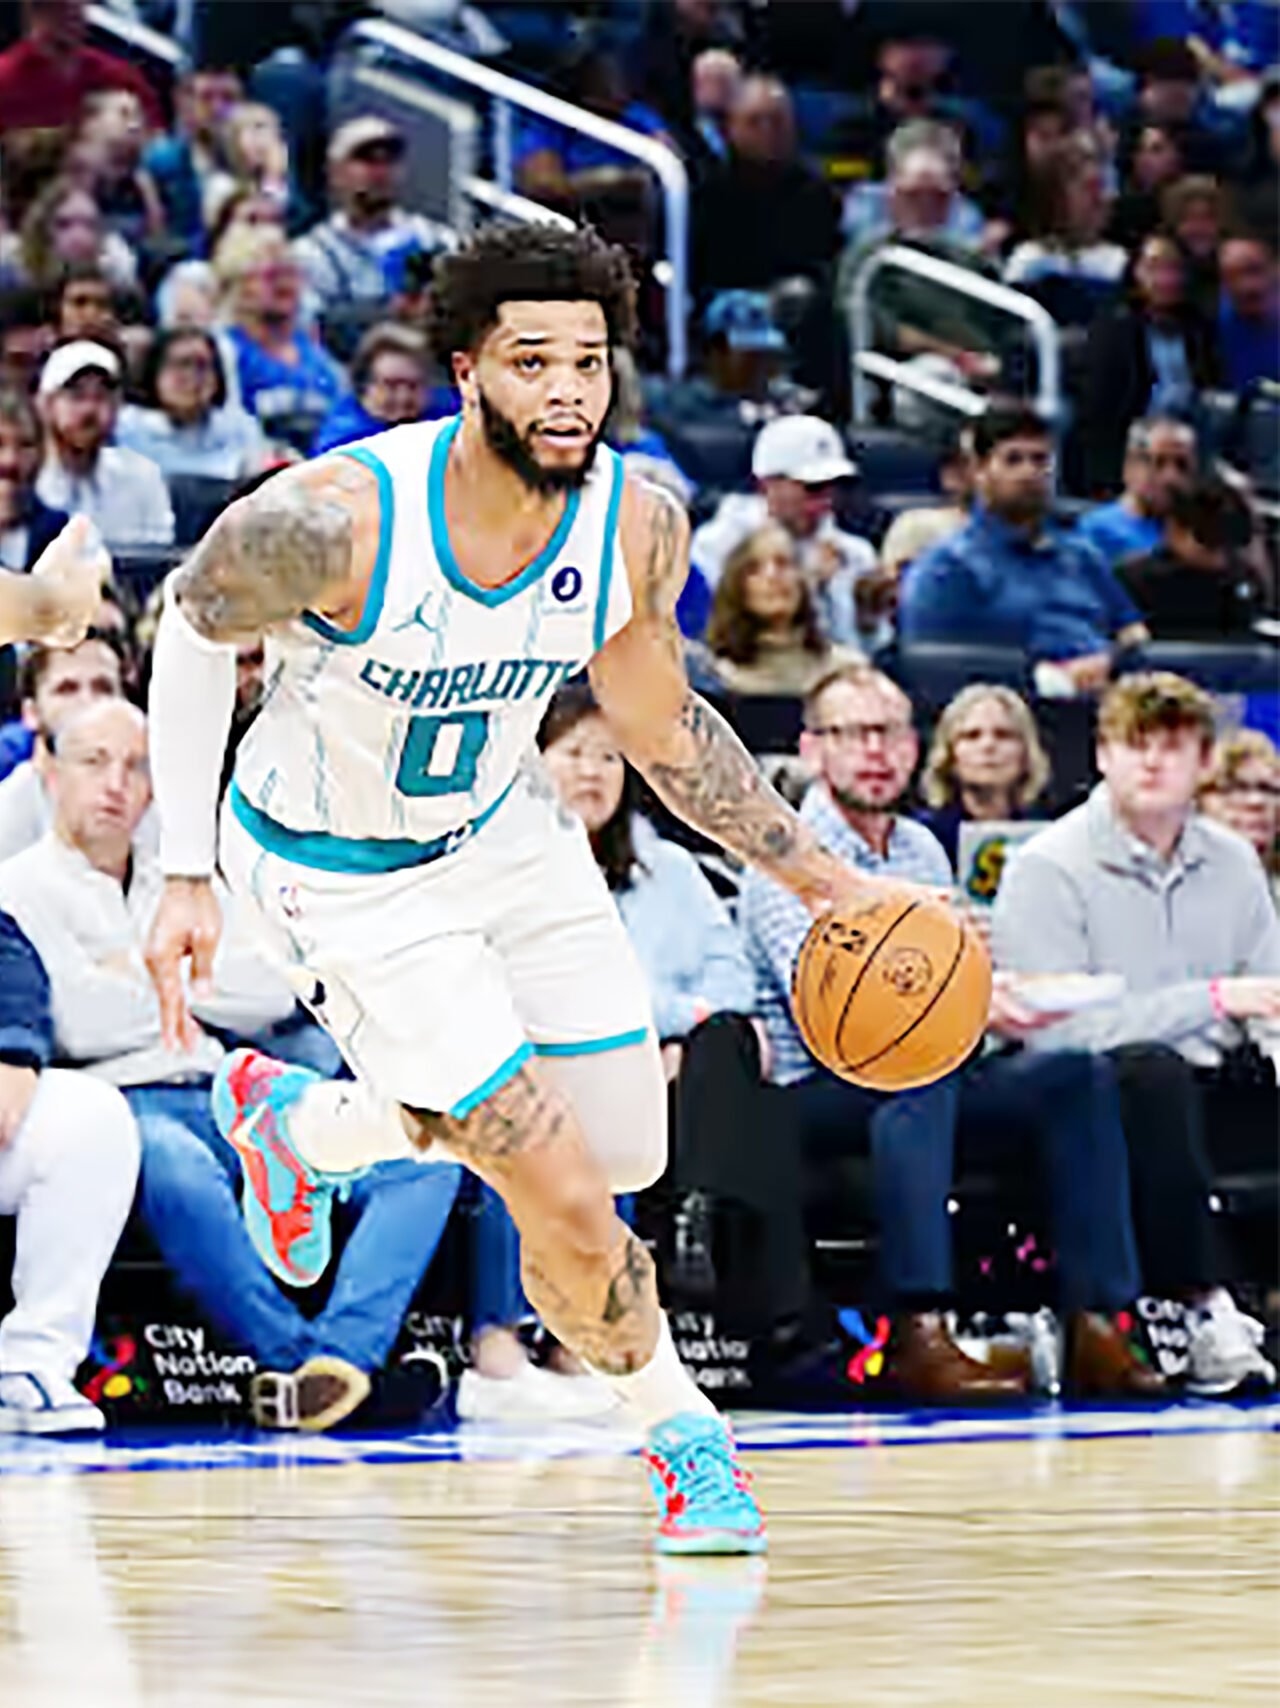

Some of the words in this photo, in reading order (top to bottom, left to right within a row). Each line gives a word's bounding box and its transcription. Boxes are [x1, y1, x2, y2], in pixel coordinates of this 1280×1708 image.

[394, 709, 490, 798] 0
[144, 1323, 205, 1353] City
[153, 1352, 257, 1377] Nation
[162, 1379, 242, 1405] Bank
